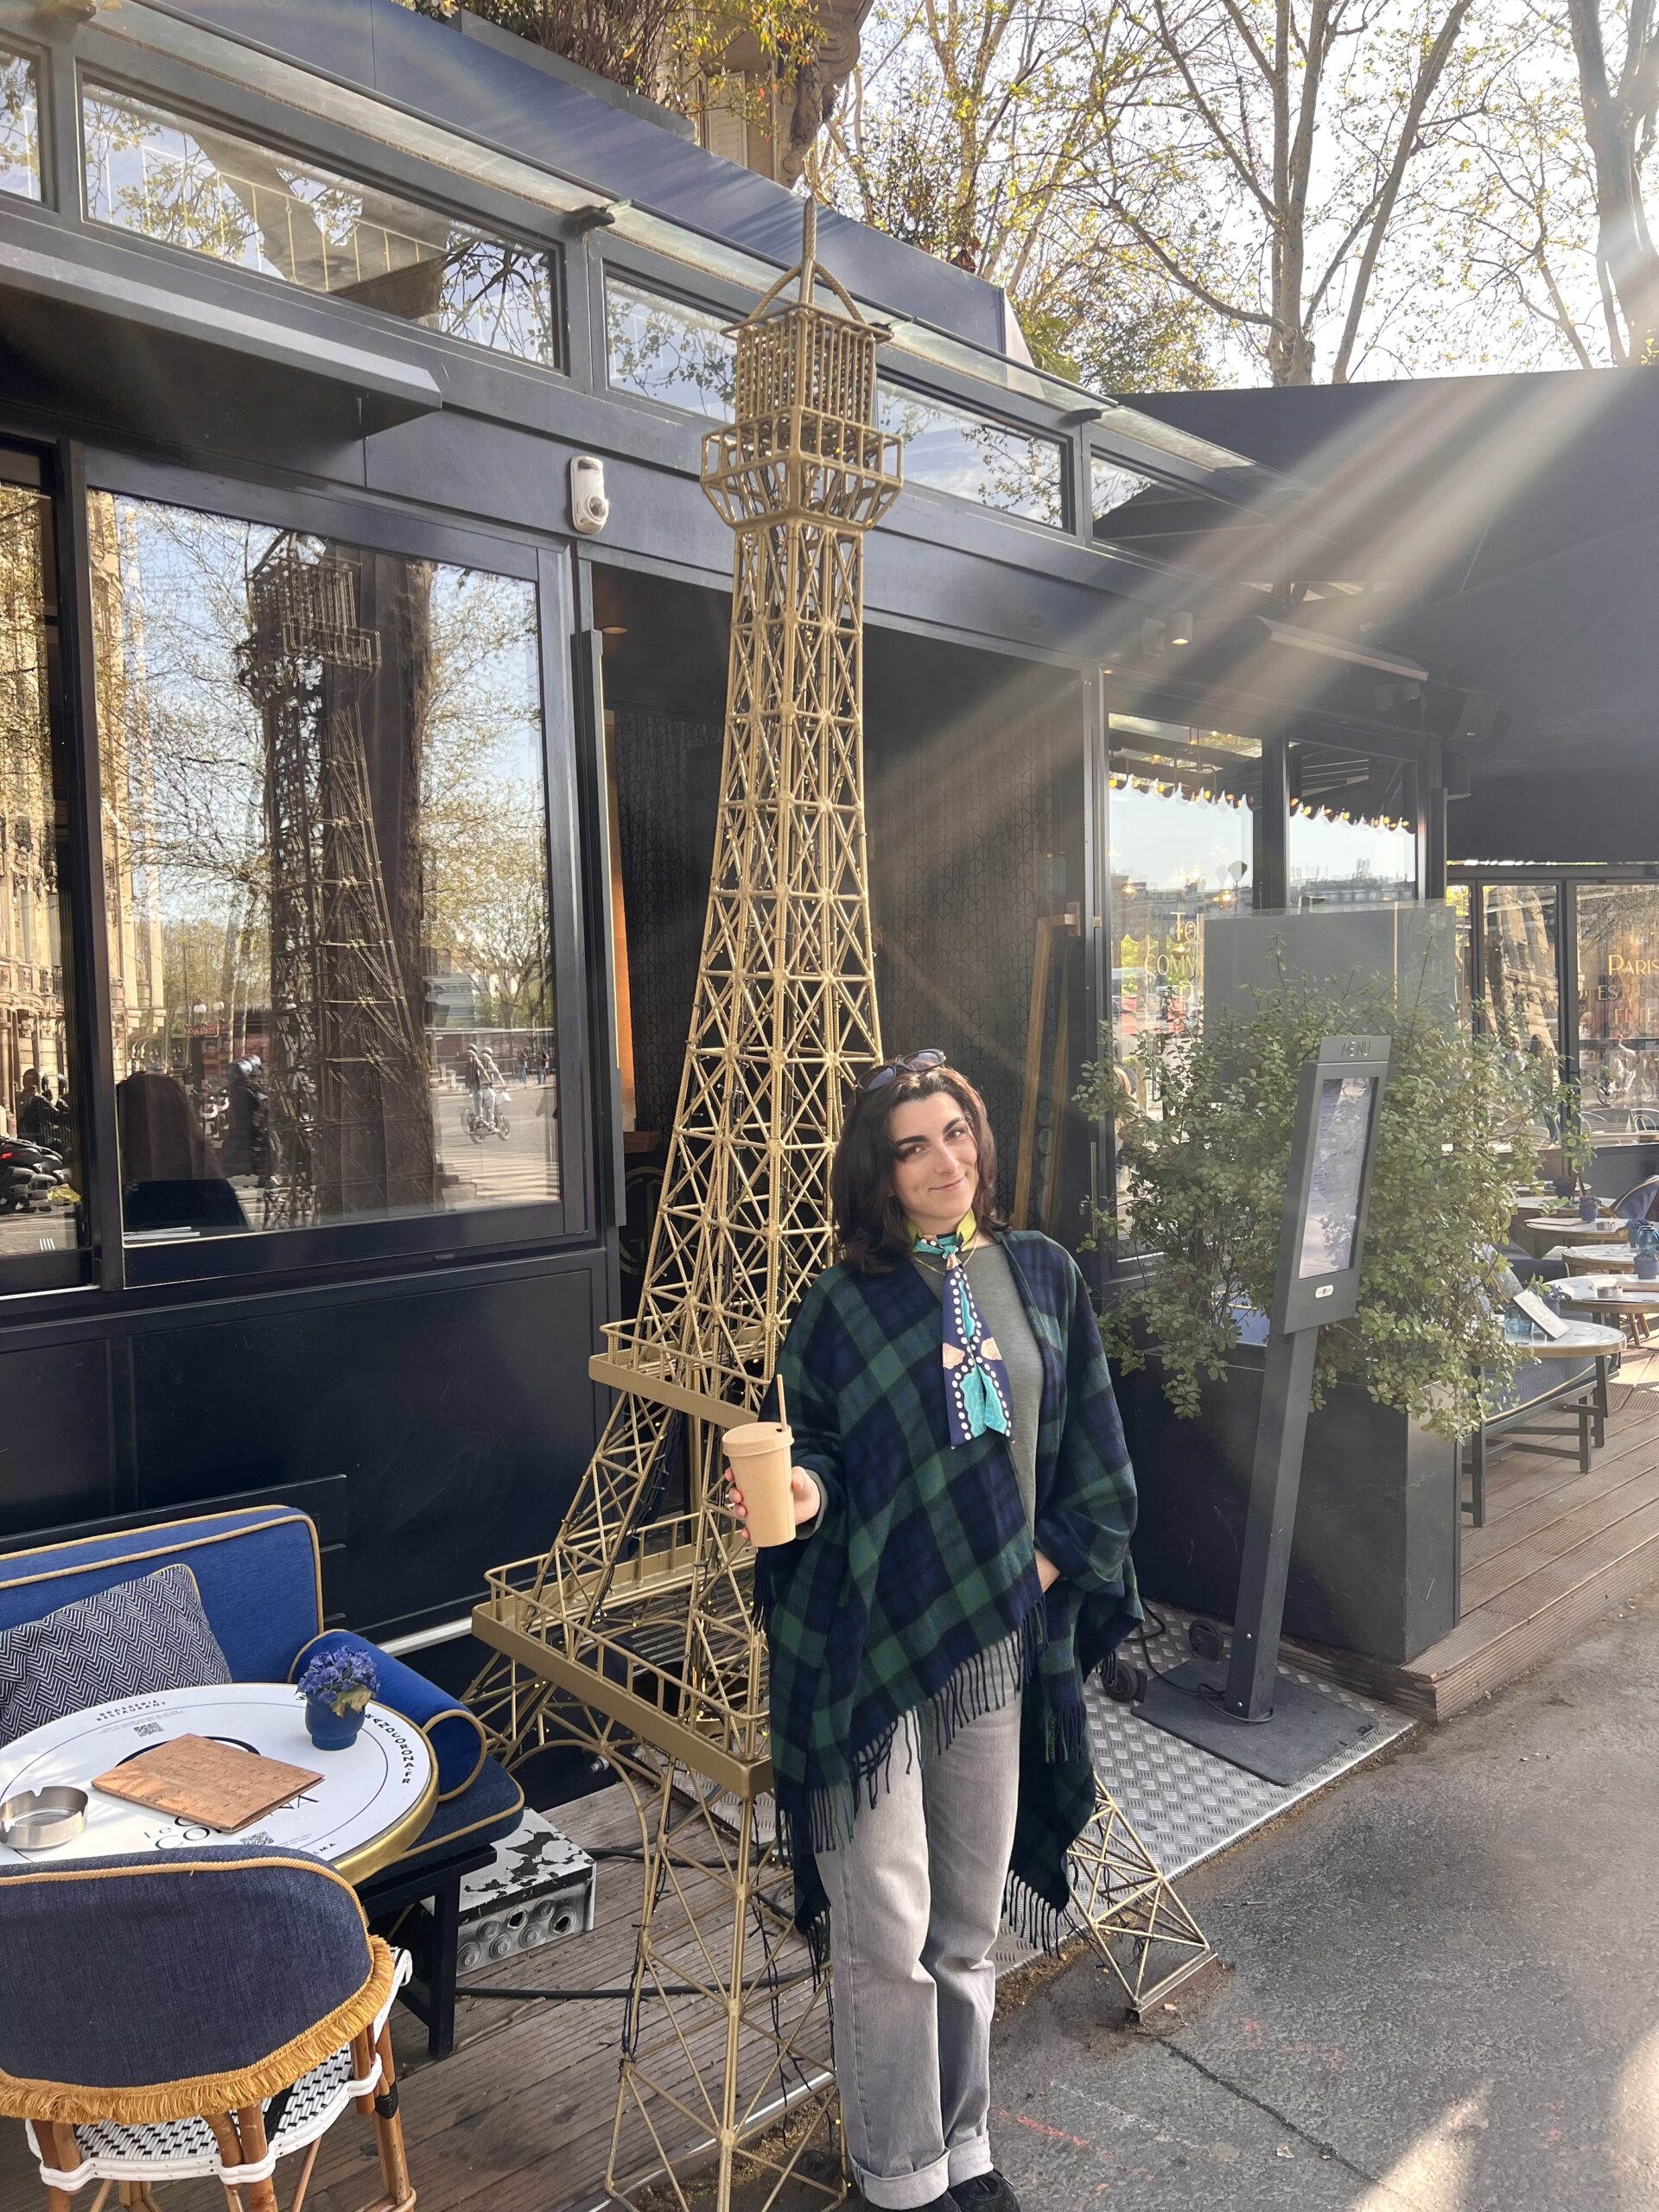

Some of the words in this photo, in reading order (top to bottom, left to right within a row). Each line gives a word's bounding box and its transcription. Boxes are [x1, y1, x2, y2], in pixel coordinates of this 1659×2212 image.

[1608, 954, 1659, 976] PARIS
[1341, 1040, 1372, 1057] MENU
[96, 1701, 166, 1721] RESTAURANT
[99, 1700, 157, 1717] BRASSERIE
[365, 1713, 415, 1784] RANDCORONA.FR
[313, 1843, 337, 1854] LMA
